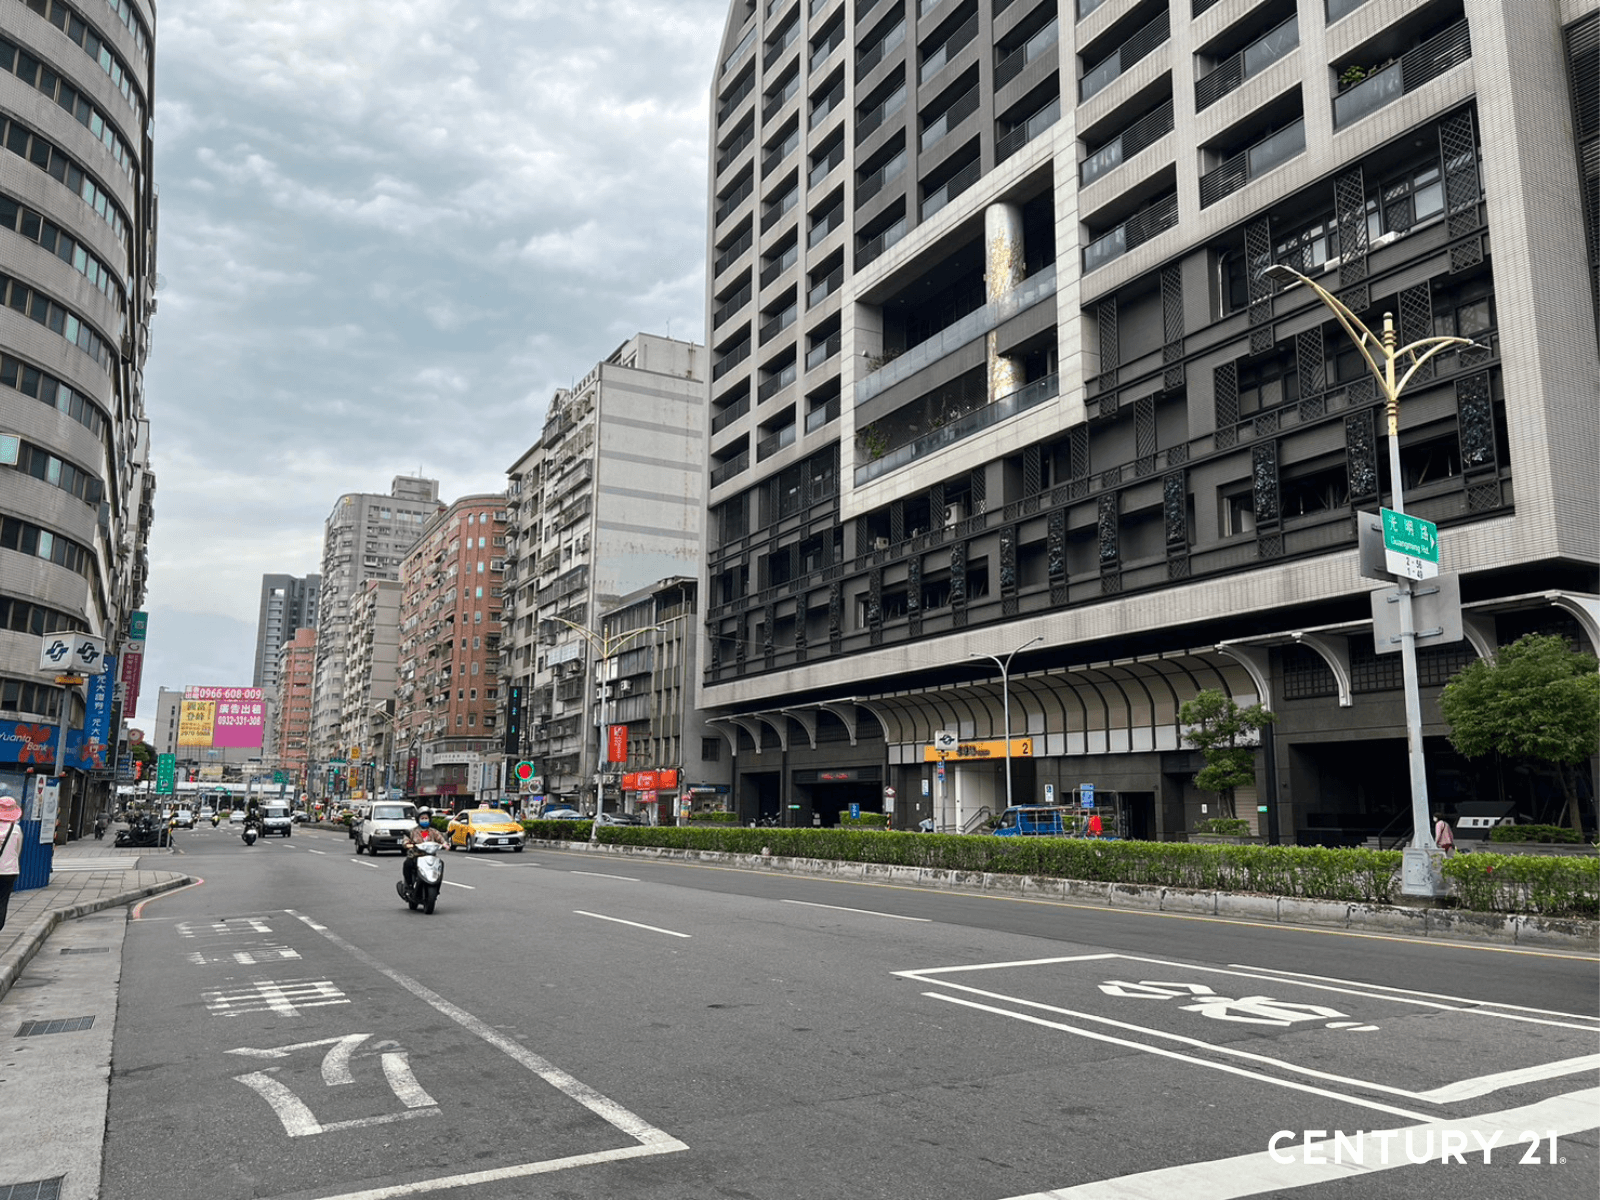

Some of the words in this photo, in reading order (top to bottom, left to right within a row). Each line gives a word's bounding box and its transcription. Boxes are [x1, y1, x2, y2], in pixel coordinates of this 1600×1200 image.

[1388, 514, 1429, 541] 光明路
[1391, 535, 1421, 555] Guangming
[219, 703, 261, 714] 廣告出租
[27, 741, 48, 751] Bank
[1022, 742, 1029, 754] 2
